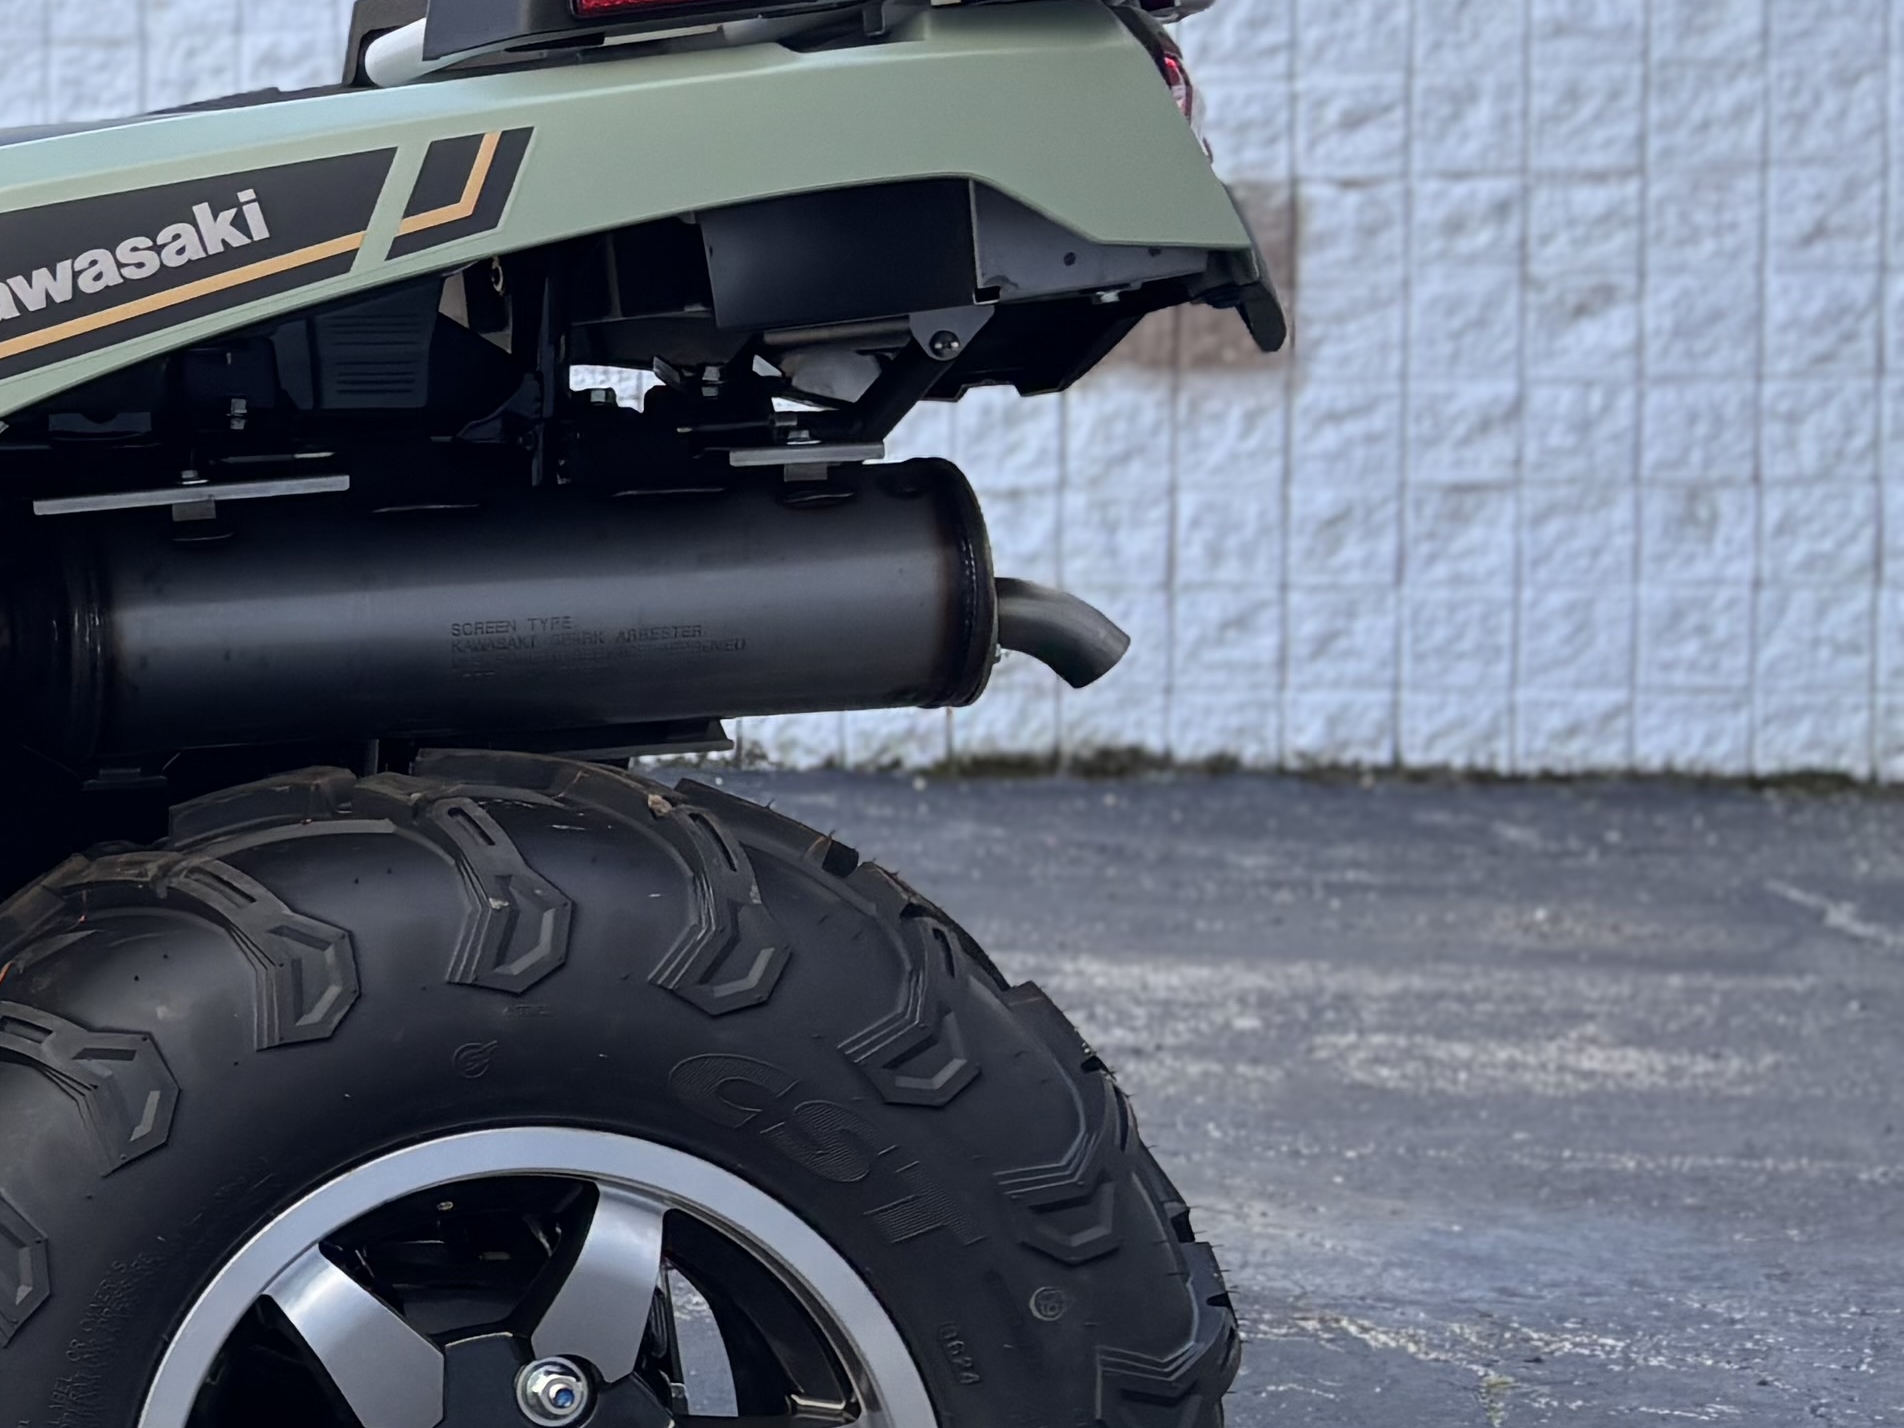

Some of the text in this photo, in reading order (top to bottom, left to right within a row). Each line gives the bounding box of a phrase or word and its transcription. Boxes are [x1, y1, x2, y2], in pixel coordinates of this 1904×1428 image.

[451, 615, 573, 637] SCREEN TYPE
[667, 1052, 985, 1248] CST
